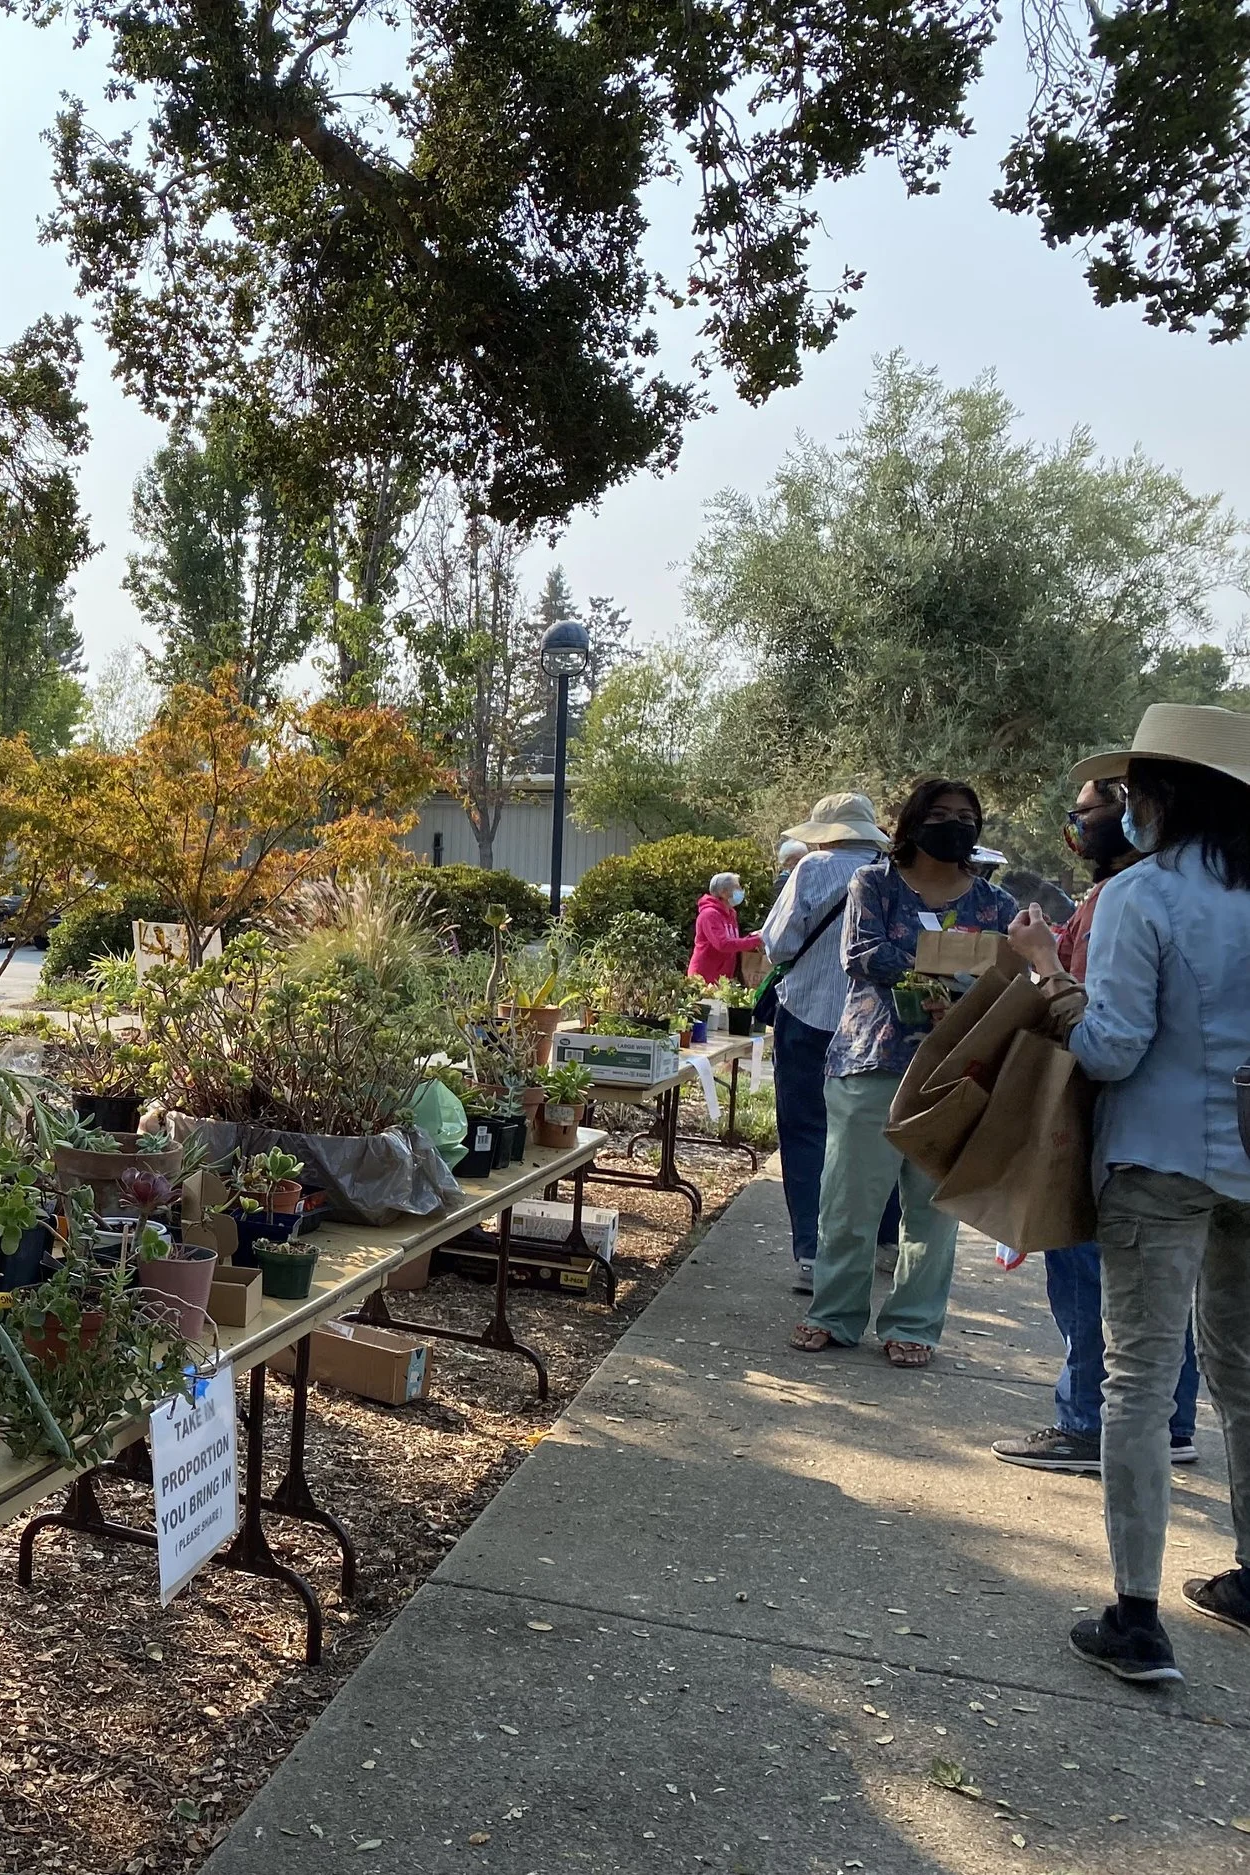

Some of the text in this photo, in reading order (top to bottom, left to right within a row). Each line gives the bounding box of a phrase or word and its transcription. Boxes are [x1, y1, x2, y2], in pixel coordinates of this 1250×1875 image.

[174, 1398, 216, 1441] TAKE IN
[161, 1432, 229, 1497] PROPORTION
[161, 1466, 232, 1535] YOU BRING IN
